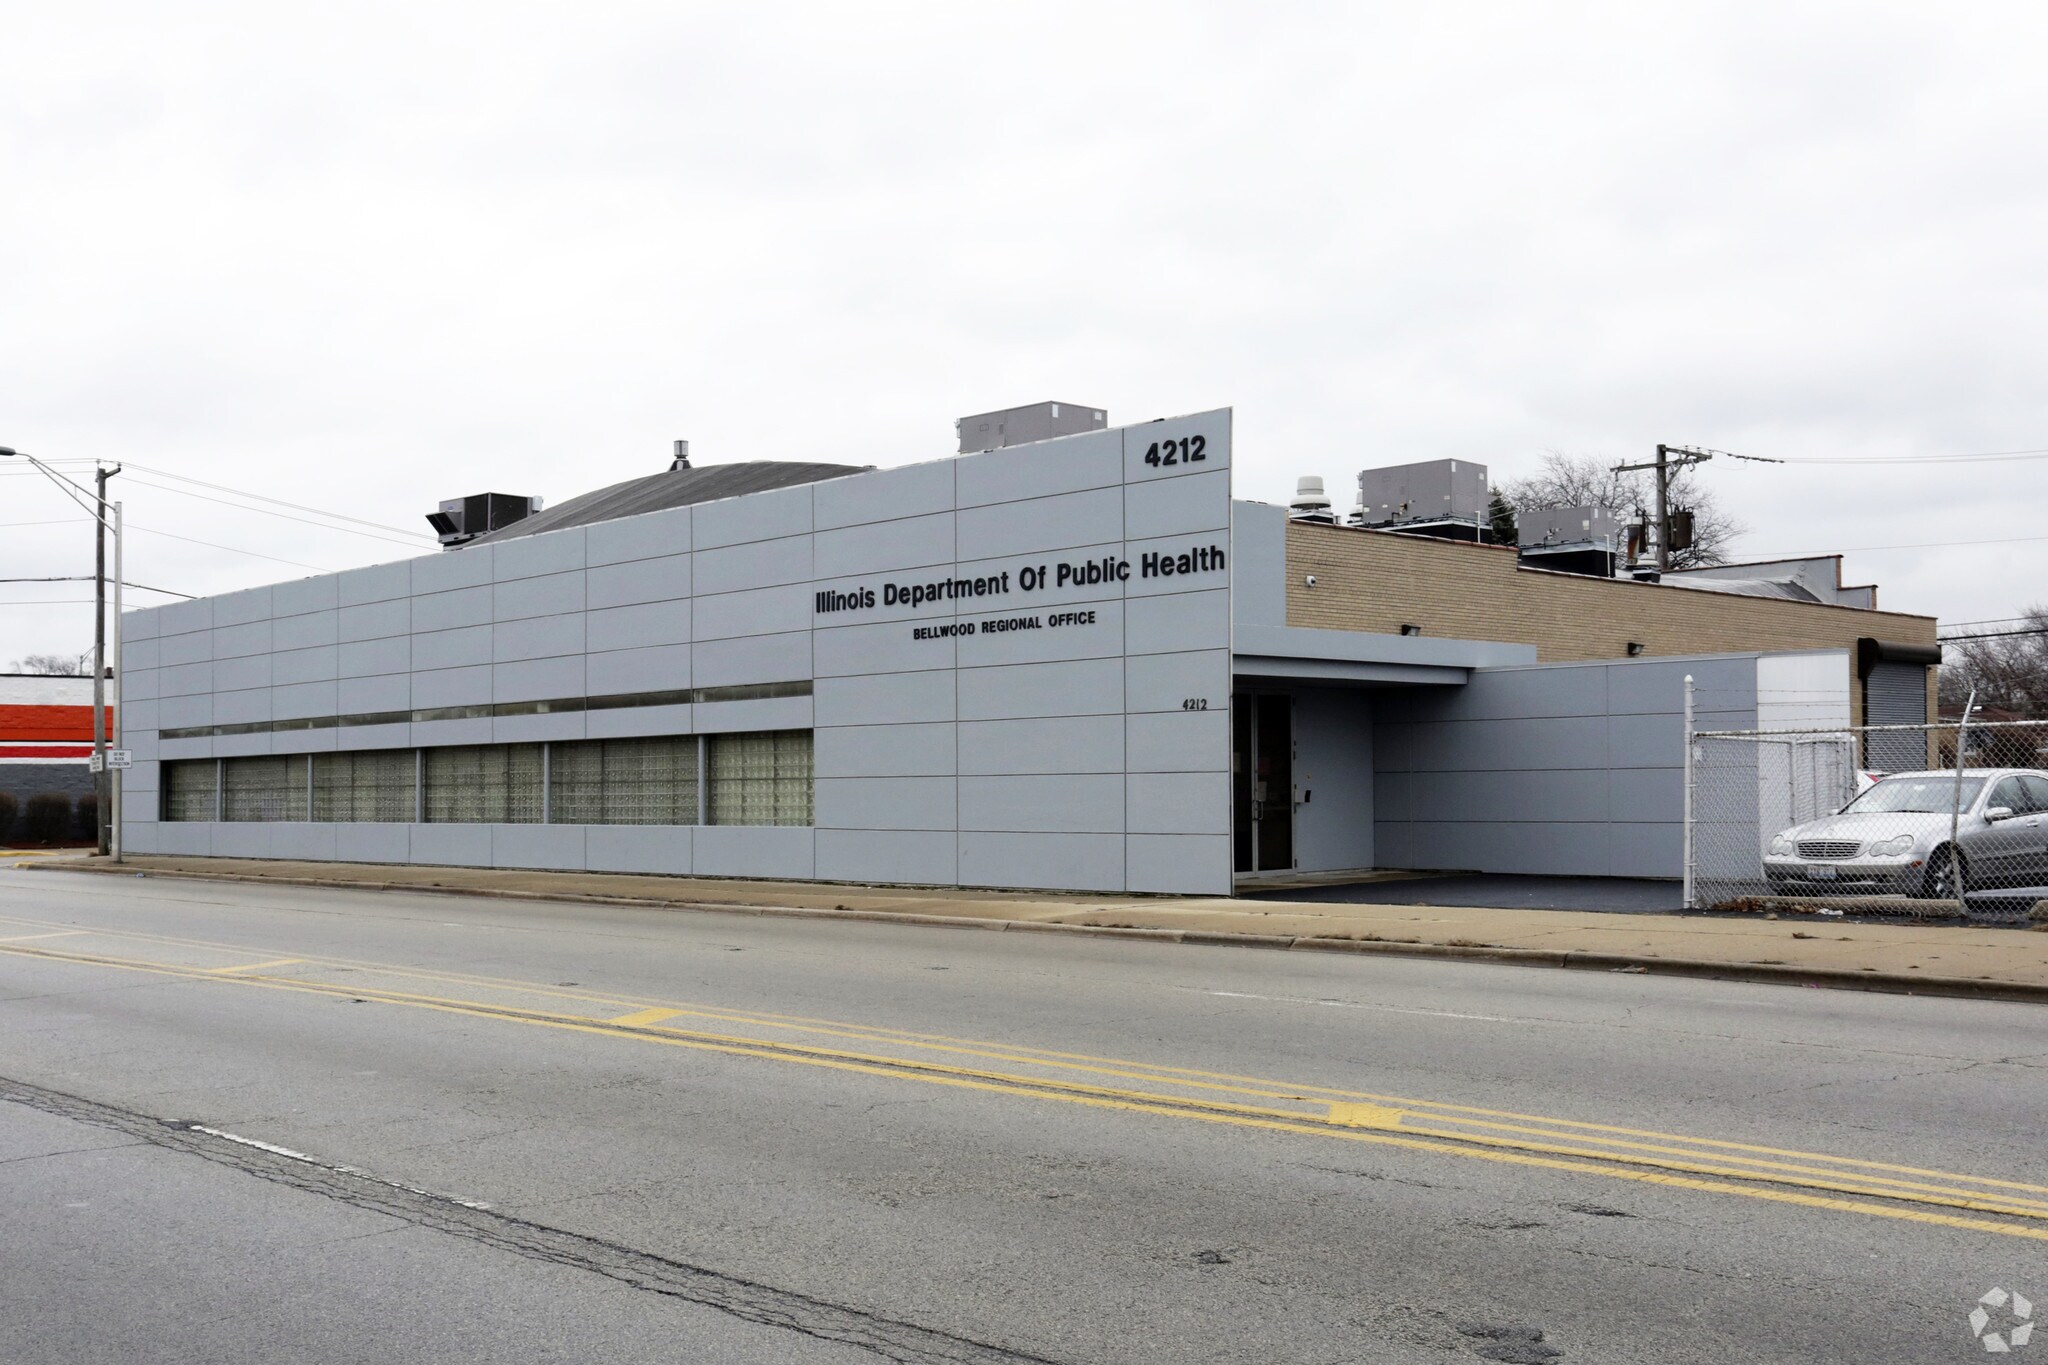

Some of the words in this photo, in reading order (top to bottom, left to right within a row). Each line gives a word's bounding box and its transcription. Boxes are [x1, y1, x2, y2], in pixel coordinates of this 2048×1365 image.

[1144, 434, 1207, 468] 4212
[815, 587, 876, 614] Illinois
[883, 571, 1009, 608] Department
[1019, 565, 1048, 592] Of
[1056, 555, 1131, 588] Public
[1141, 545, 1226, 579] Health
[913, 622, 976, 641] BELLWOOD
[981, 616, 1043, 634] REGIONAL
[1048, 611, 1096, 628] OFFICE
[1182, 698, 1207, 710] 4212
